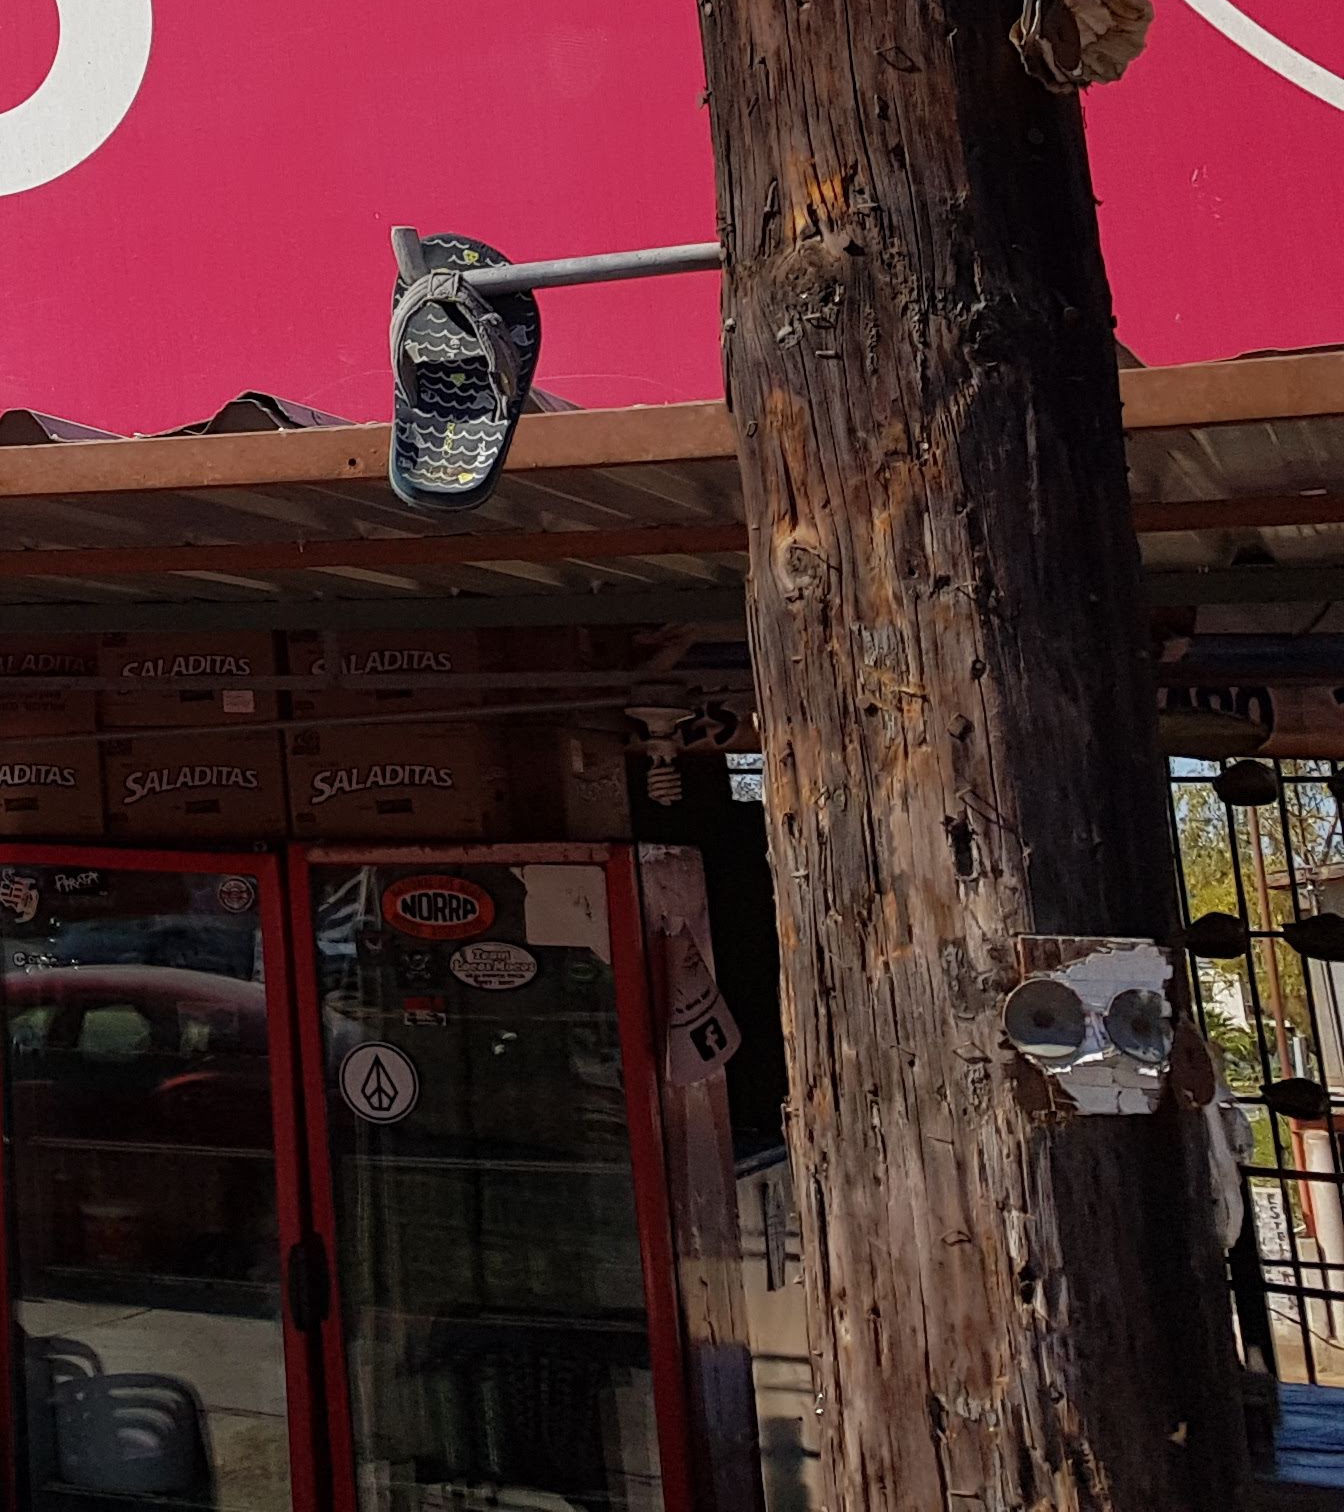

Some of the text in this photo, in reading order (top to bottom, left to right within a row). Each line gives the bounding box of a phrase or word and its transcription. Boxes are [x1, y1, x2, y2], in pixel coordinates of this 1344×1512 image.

[122, 764, 260, 805] SALADITAS
[310, 763, 453, 806] SALADITAS
[401, 891, 477, 923] NORRA
